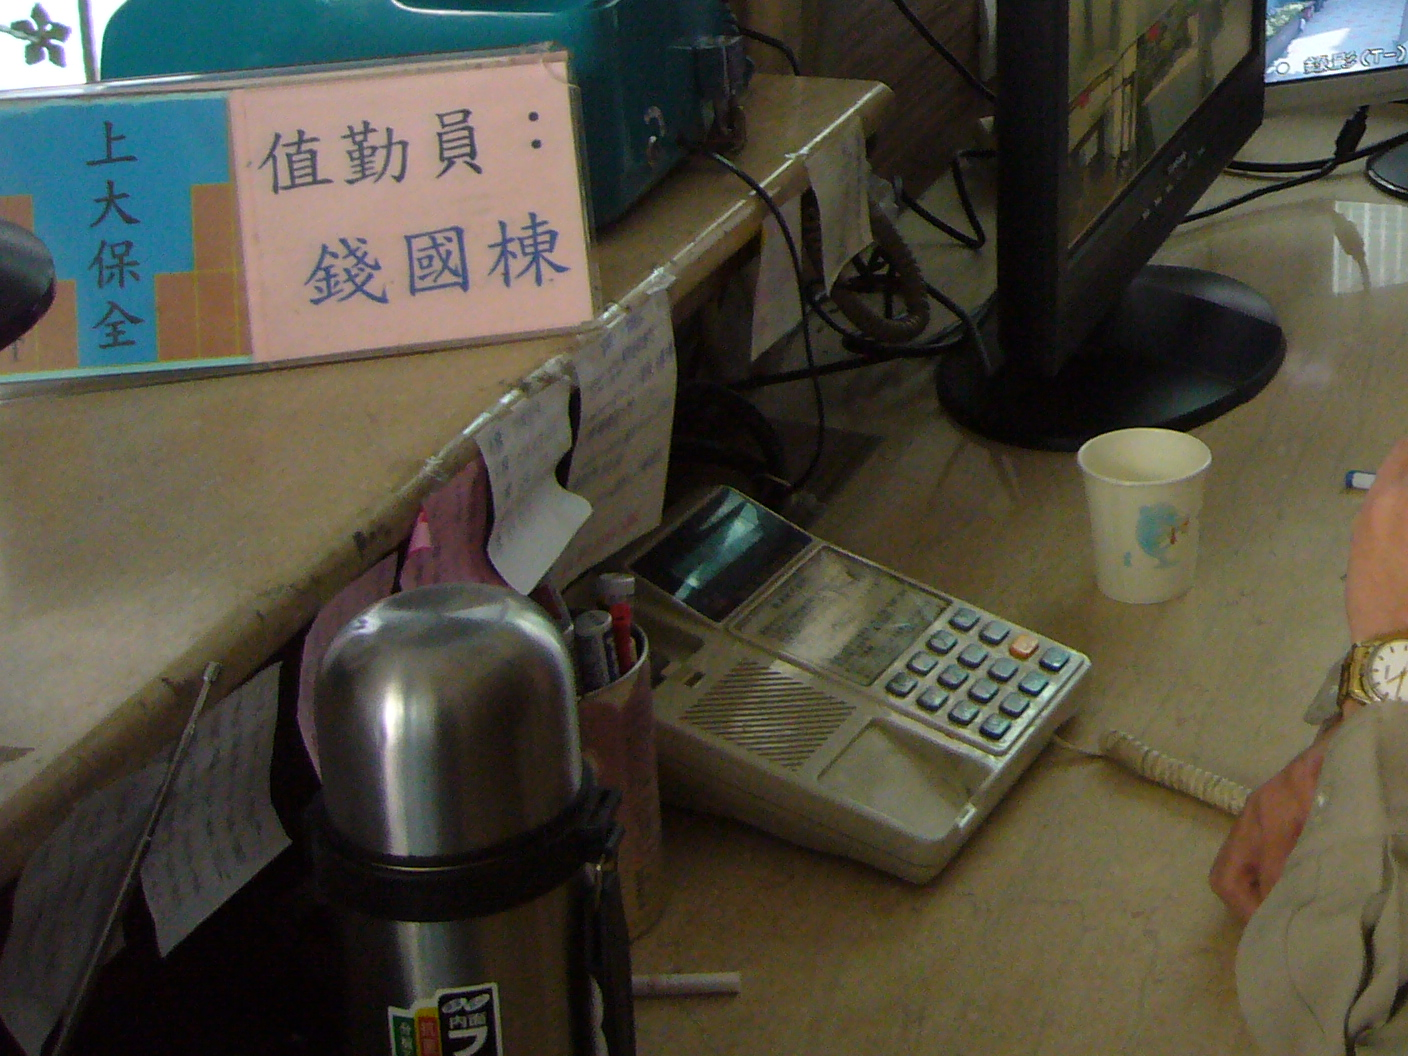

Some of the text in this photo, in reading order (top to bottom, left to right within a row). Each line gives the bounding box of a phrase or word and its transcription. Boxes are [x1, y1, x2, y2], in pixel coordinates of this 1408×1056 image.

[86, 120, 145, 350] 上大保全
[303, 210, 572, 307] 錢國棟
